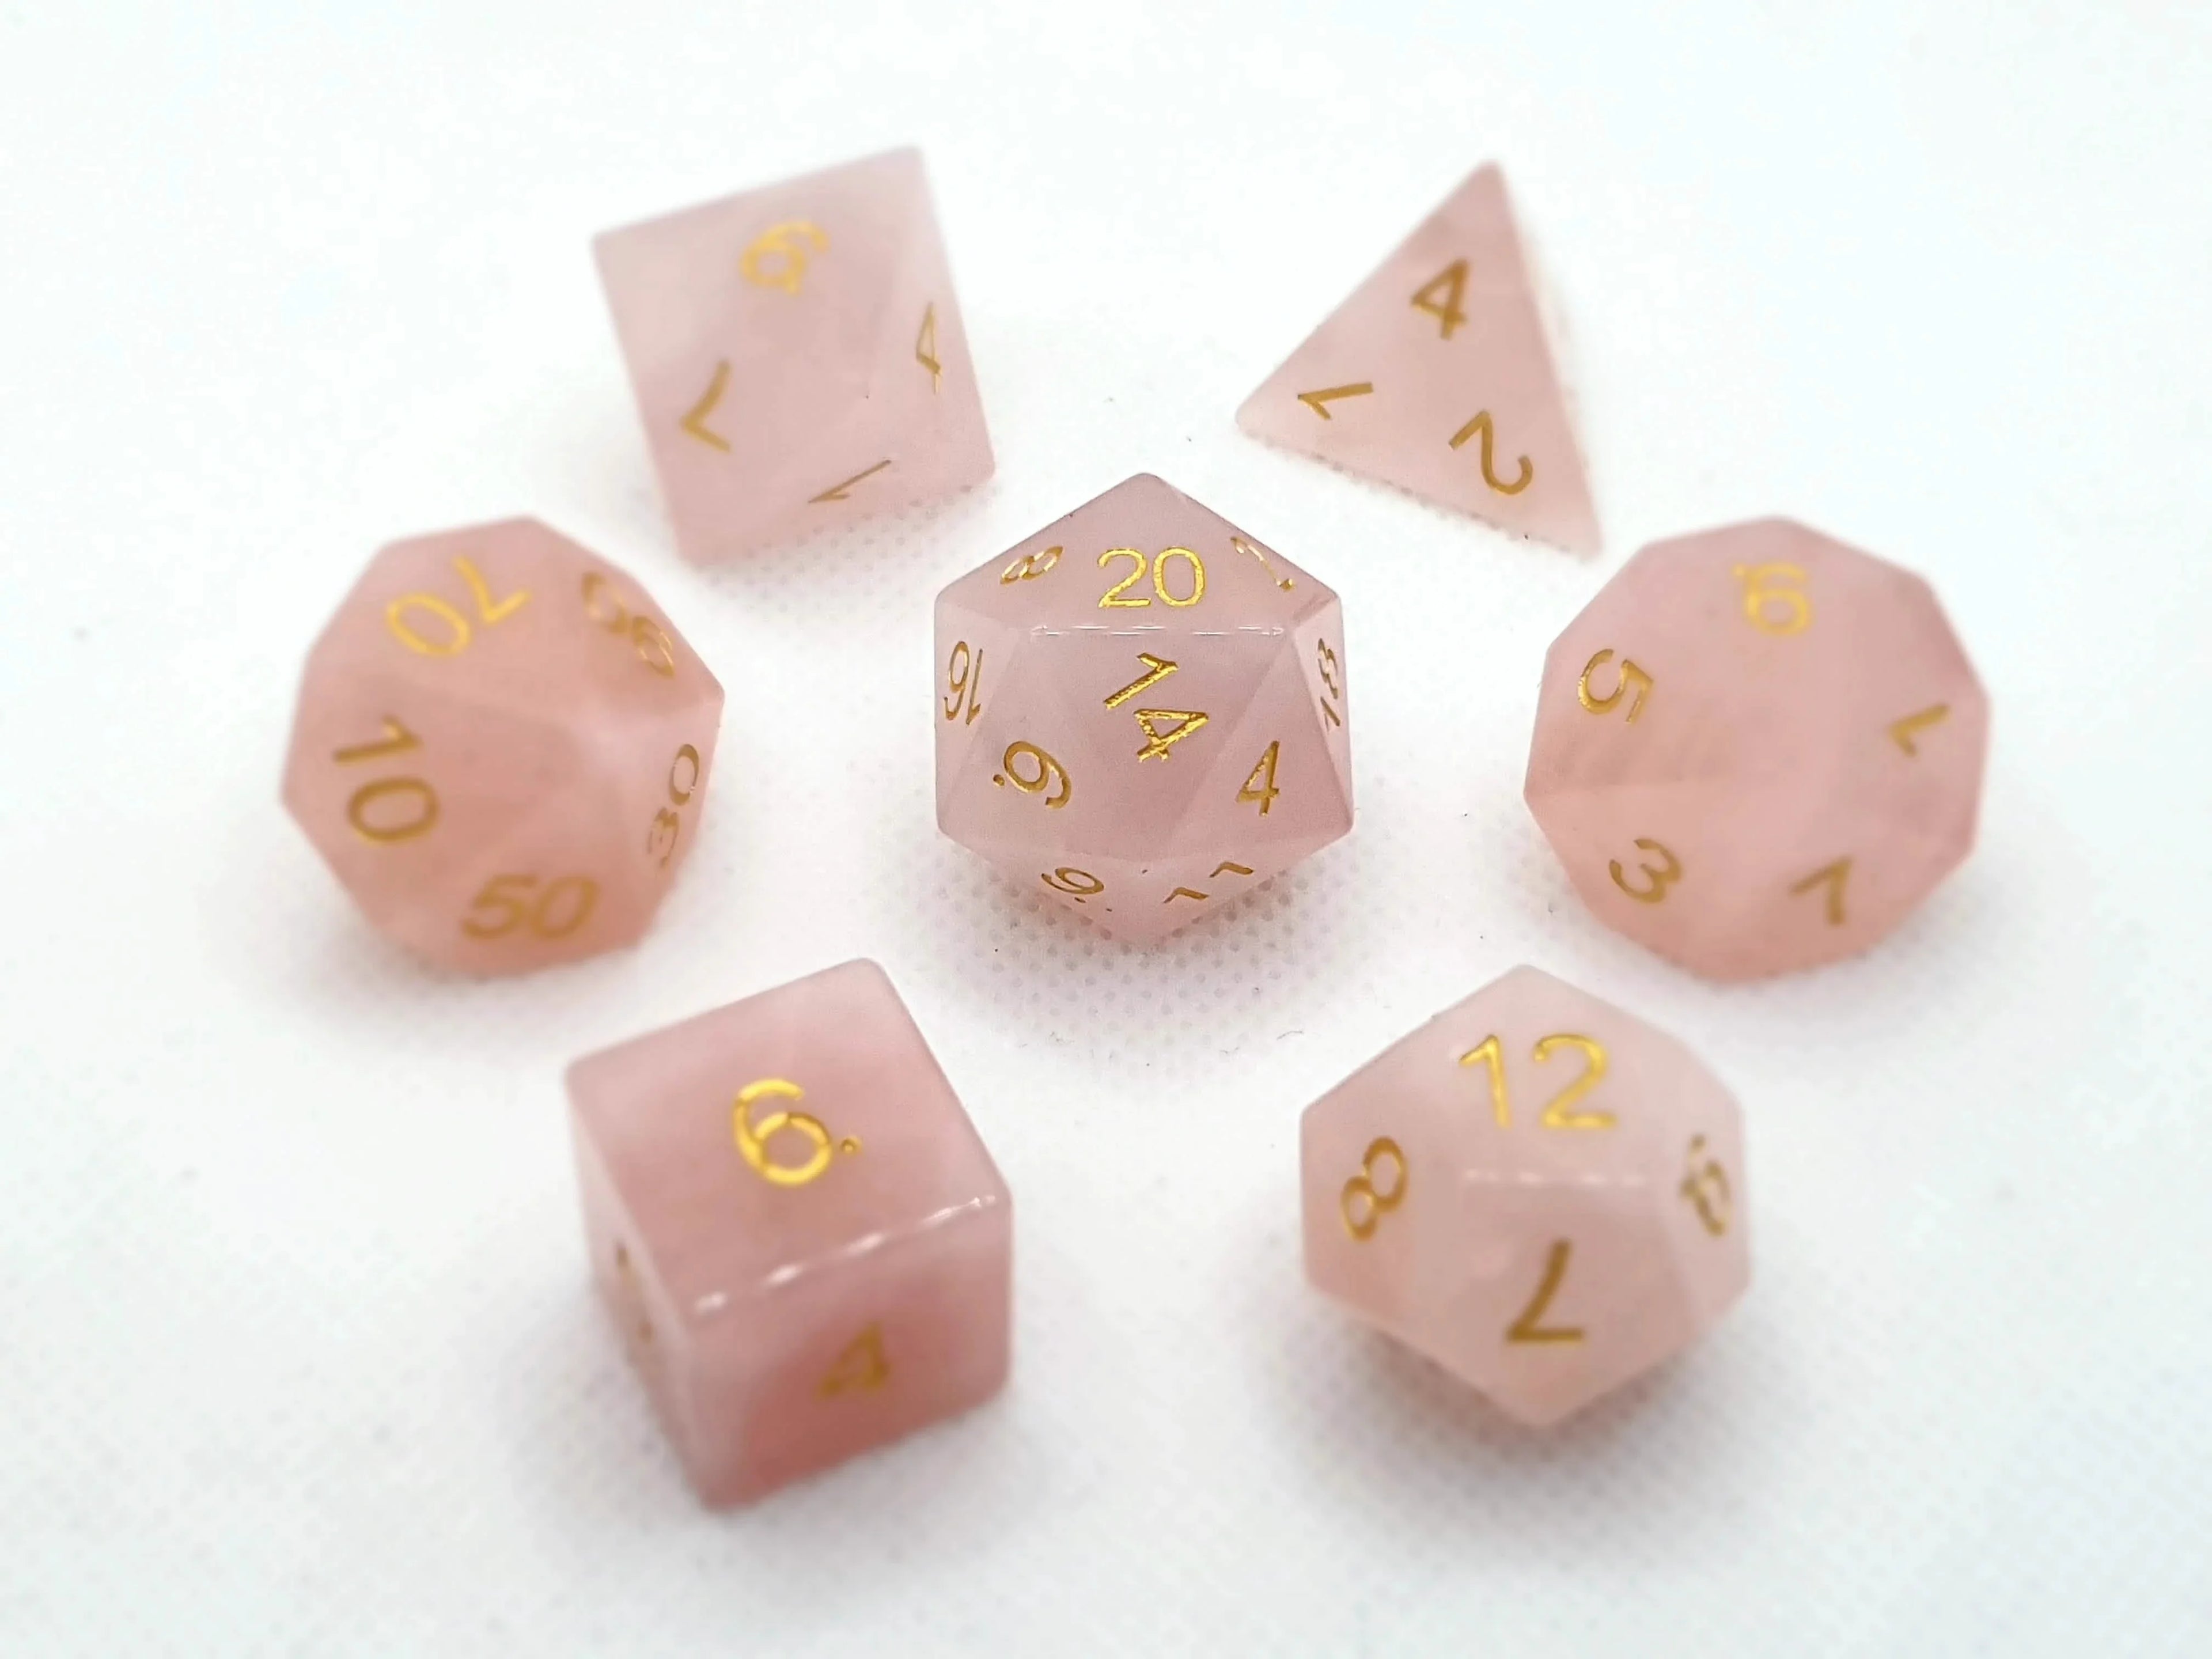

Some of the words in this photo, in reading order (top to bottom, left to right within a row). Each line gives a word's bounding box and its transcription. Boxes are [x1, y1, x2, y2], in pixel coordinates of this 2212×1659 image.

[1411, 256, 1473, 341] 4
[915, 300, 944, 396] 4
[679, 358, 732, 454] 7
[1297, 381, 1374, 422] 1
[1448, 410, 1535, 497] 2
[383, 555, 532, 659] 70
[999, 544, 1065, 586] 8
[1097, 546, 1207, 609] 20
[943, 642, 983, 726] 16
[1104, 652, 1210, 762] 14
[1577, 647, 1655, 726] 5
[333, 714, 442, 850] 10
[647, 743, 700, 869] 30
[1234, 739, 1281, 818] 4
[462, 872, 602, 945] 50
[1607, 838, 1683, 906] 3
[1457, 1032, 1619, 1132] 12
[1339, 1135, 1409, 1244] 8
[1505, 1237, 1587, 1349] 7
